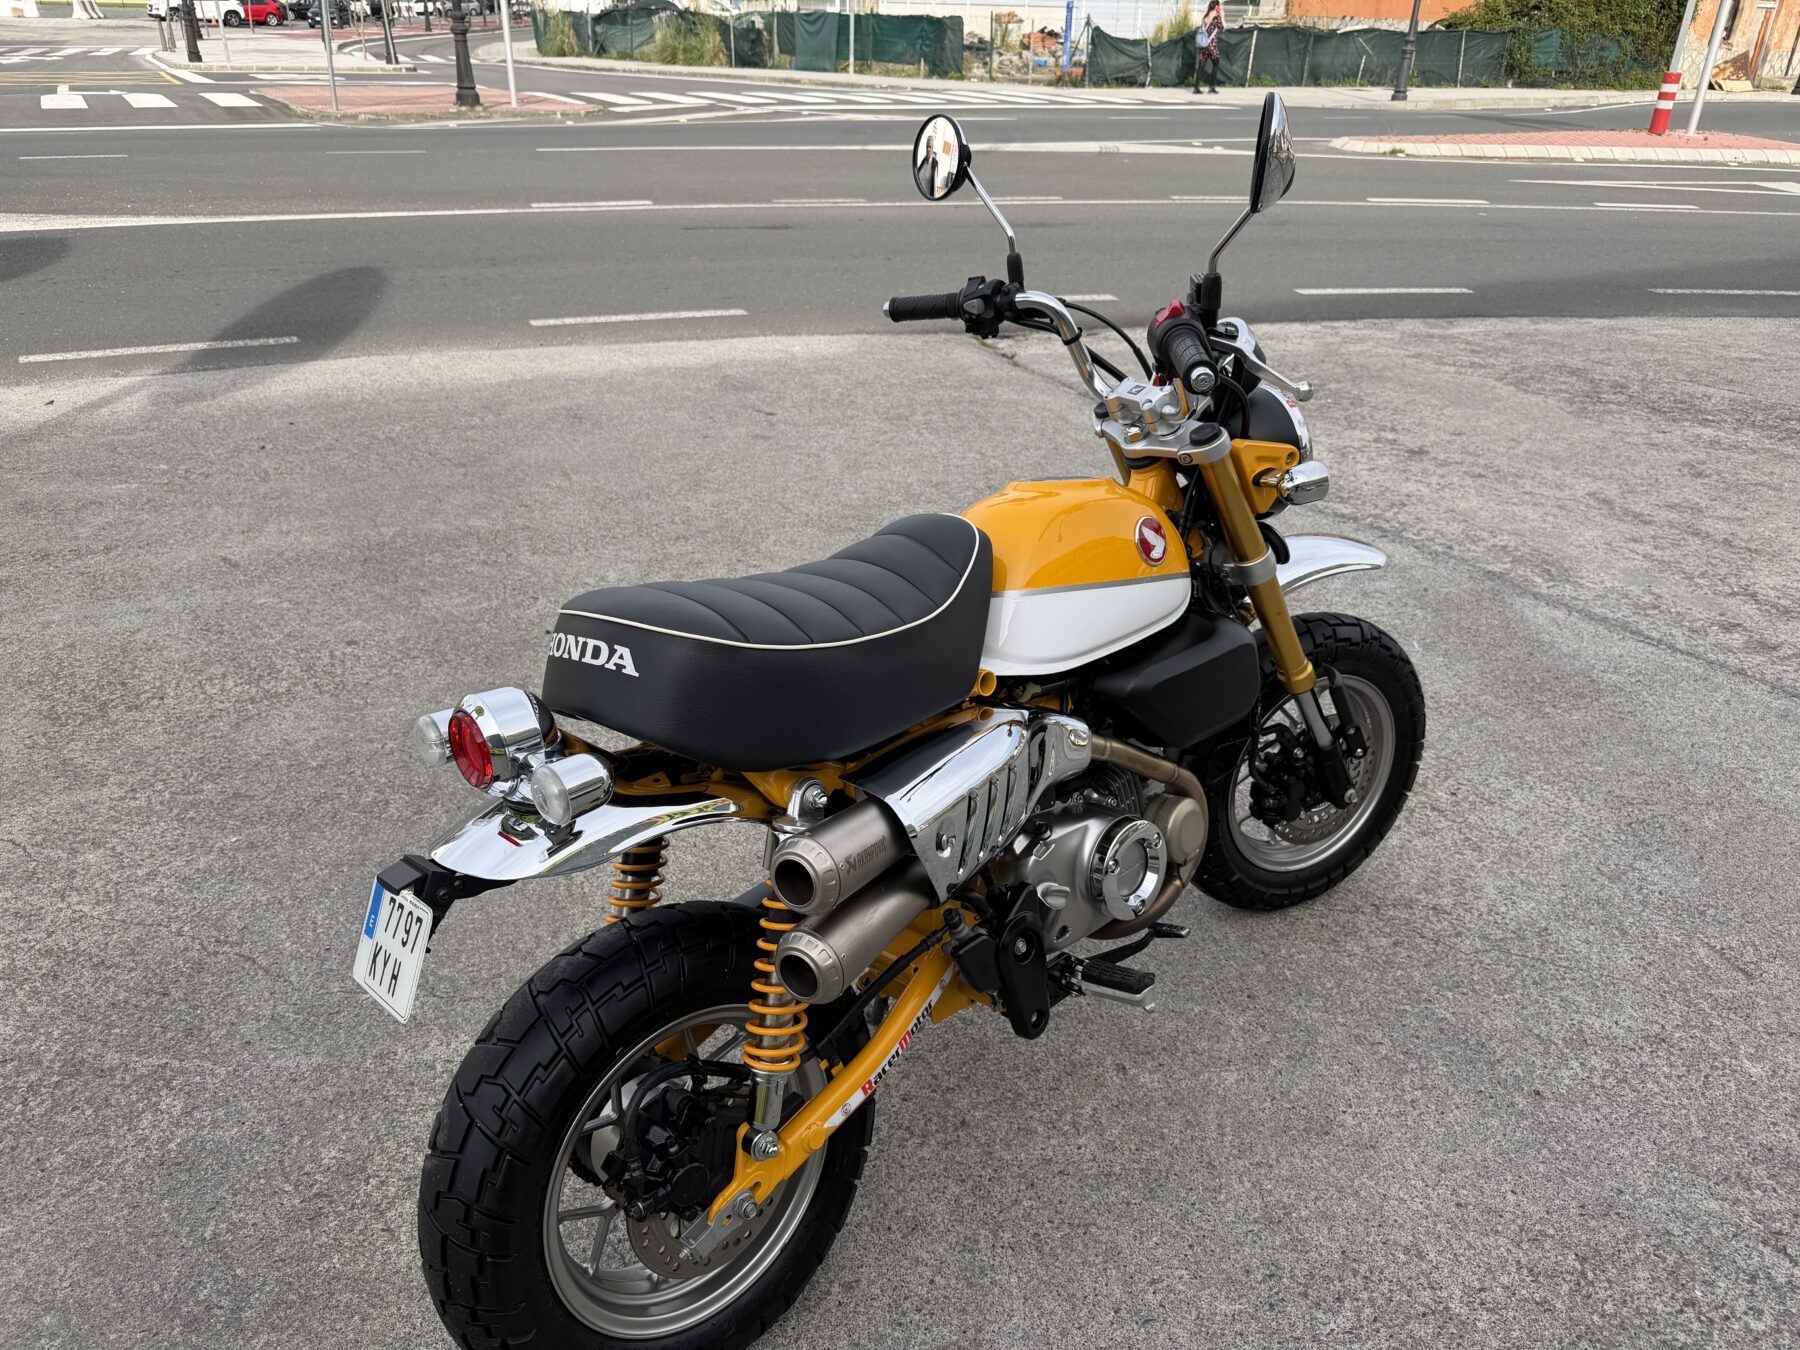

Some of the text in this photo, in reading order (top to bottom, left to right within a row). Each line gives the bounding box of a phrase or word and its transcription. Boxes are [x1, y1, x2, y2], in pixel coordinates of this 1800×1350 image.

[369, 914, 375, 928] E
[384, 896, 424, 954] 7797
[368, 941, 402, 998] KYH
